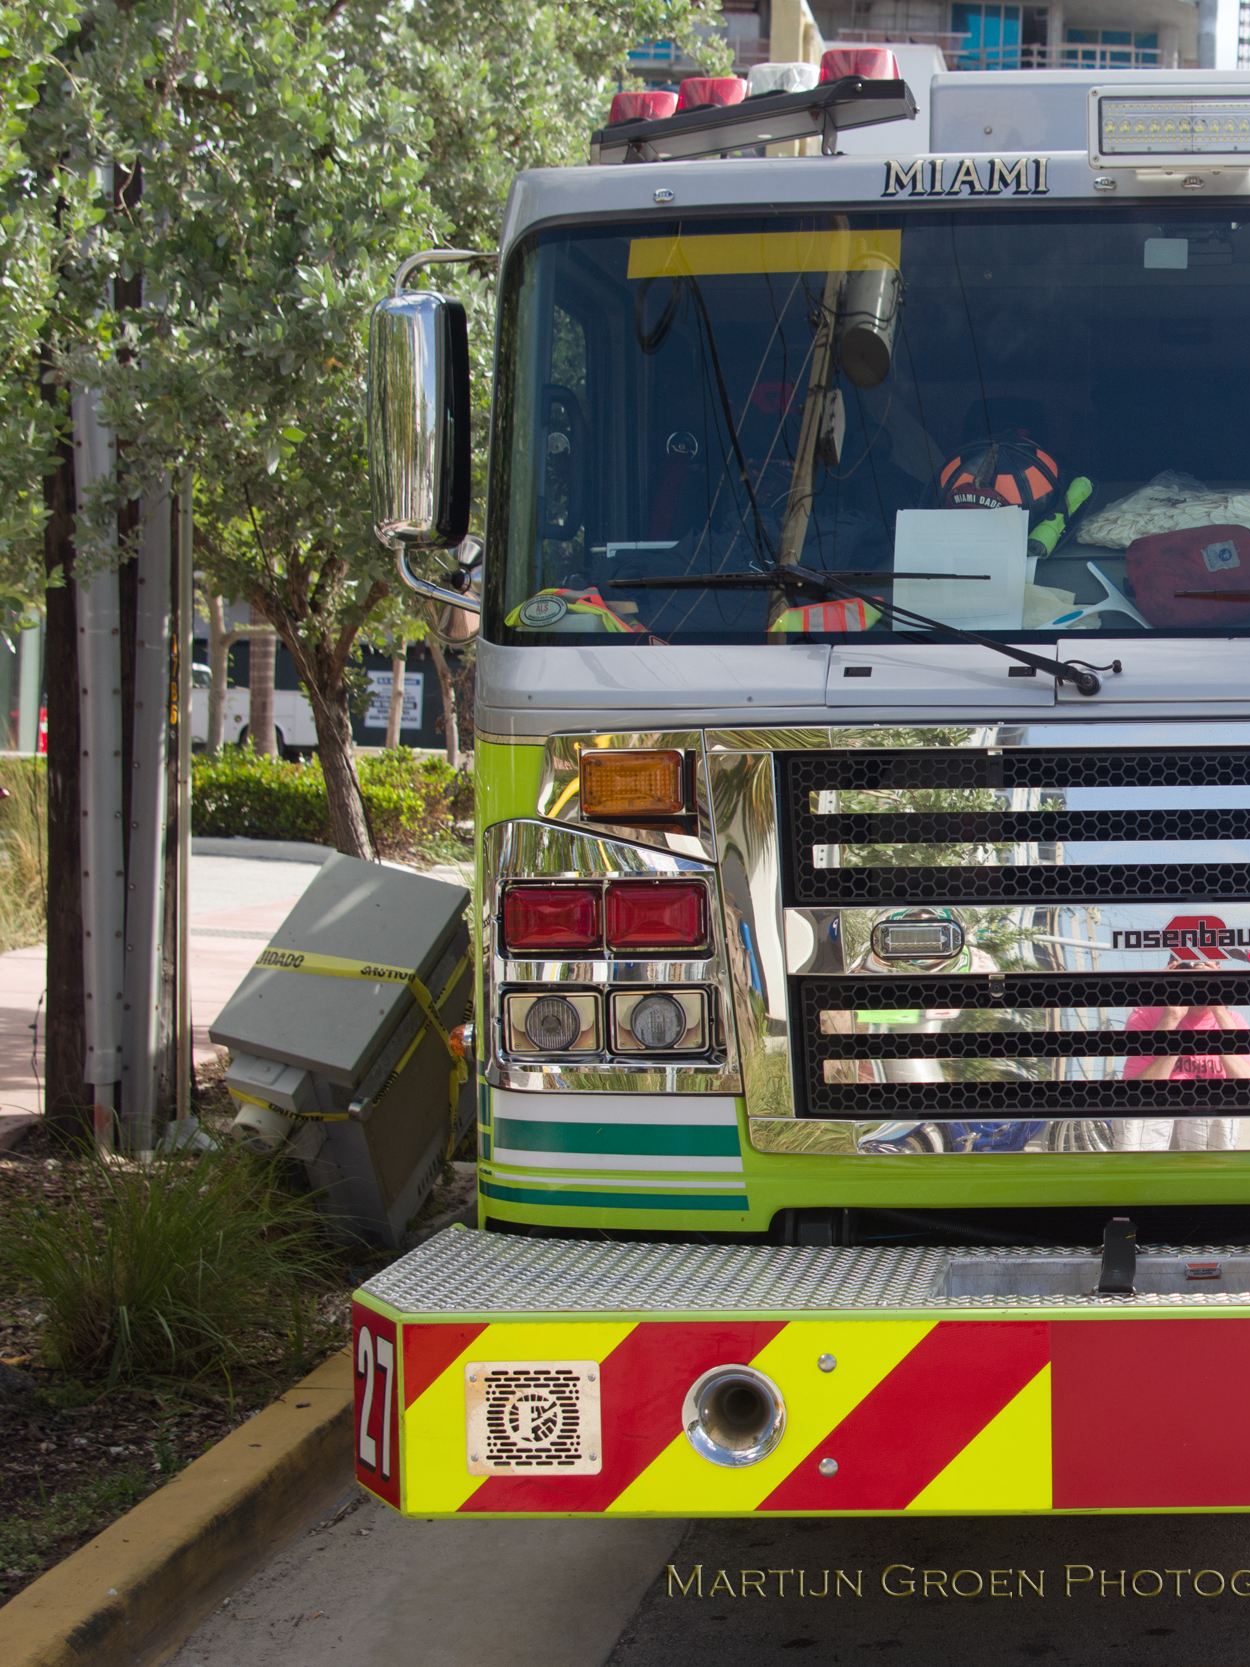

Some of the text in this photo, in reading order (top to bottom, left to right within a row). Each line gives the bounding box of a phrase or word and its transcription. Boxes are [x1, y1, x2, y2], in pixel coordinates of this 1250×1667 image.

[880, 157, 1050, 197] MIAMI
[953, 493, 1003, 509] MIAMI DADE
[535, 603, 549, 613] ALS
[256, 950, 305, 969] UIDADO
[357, 1324, 394, 1483] 27
